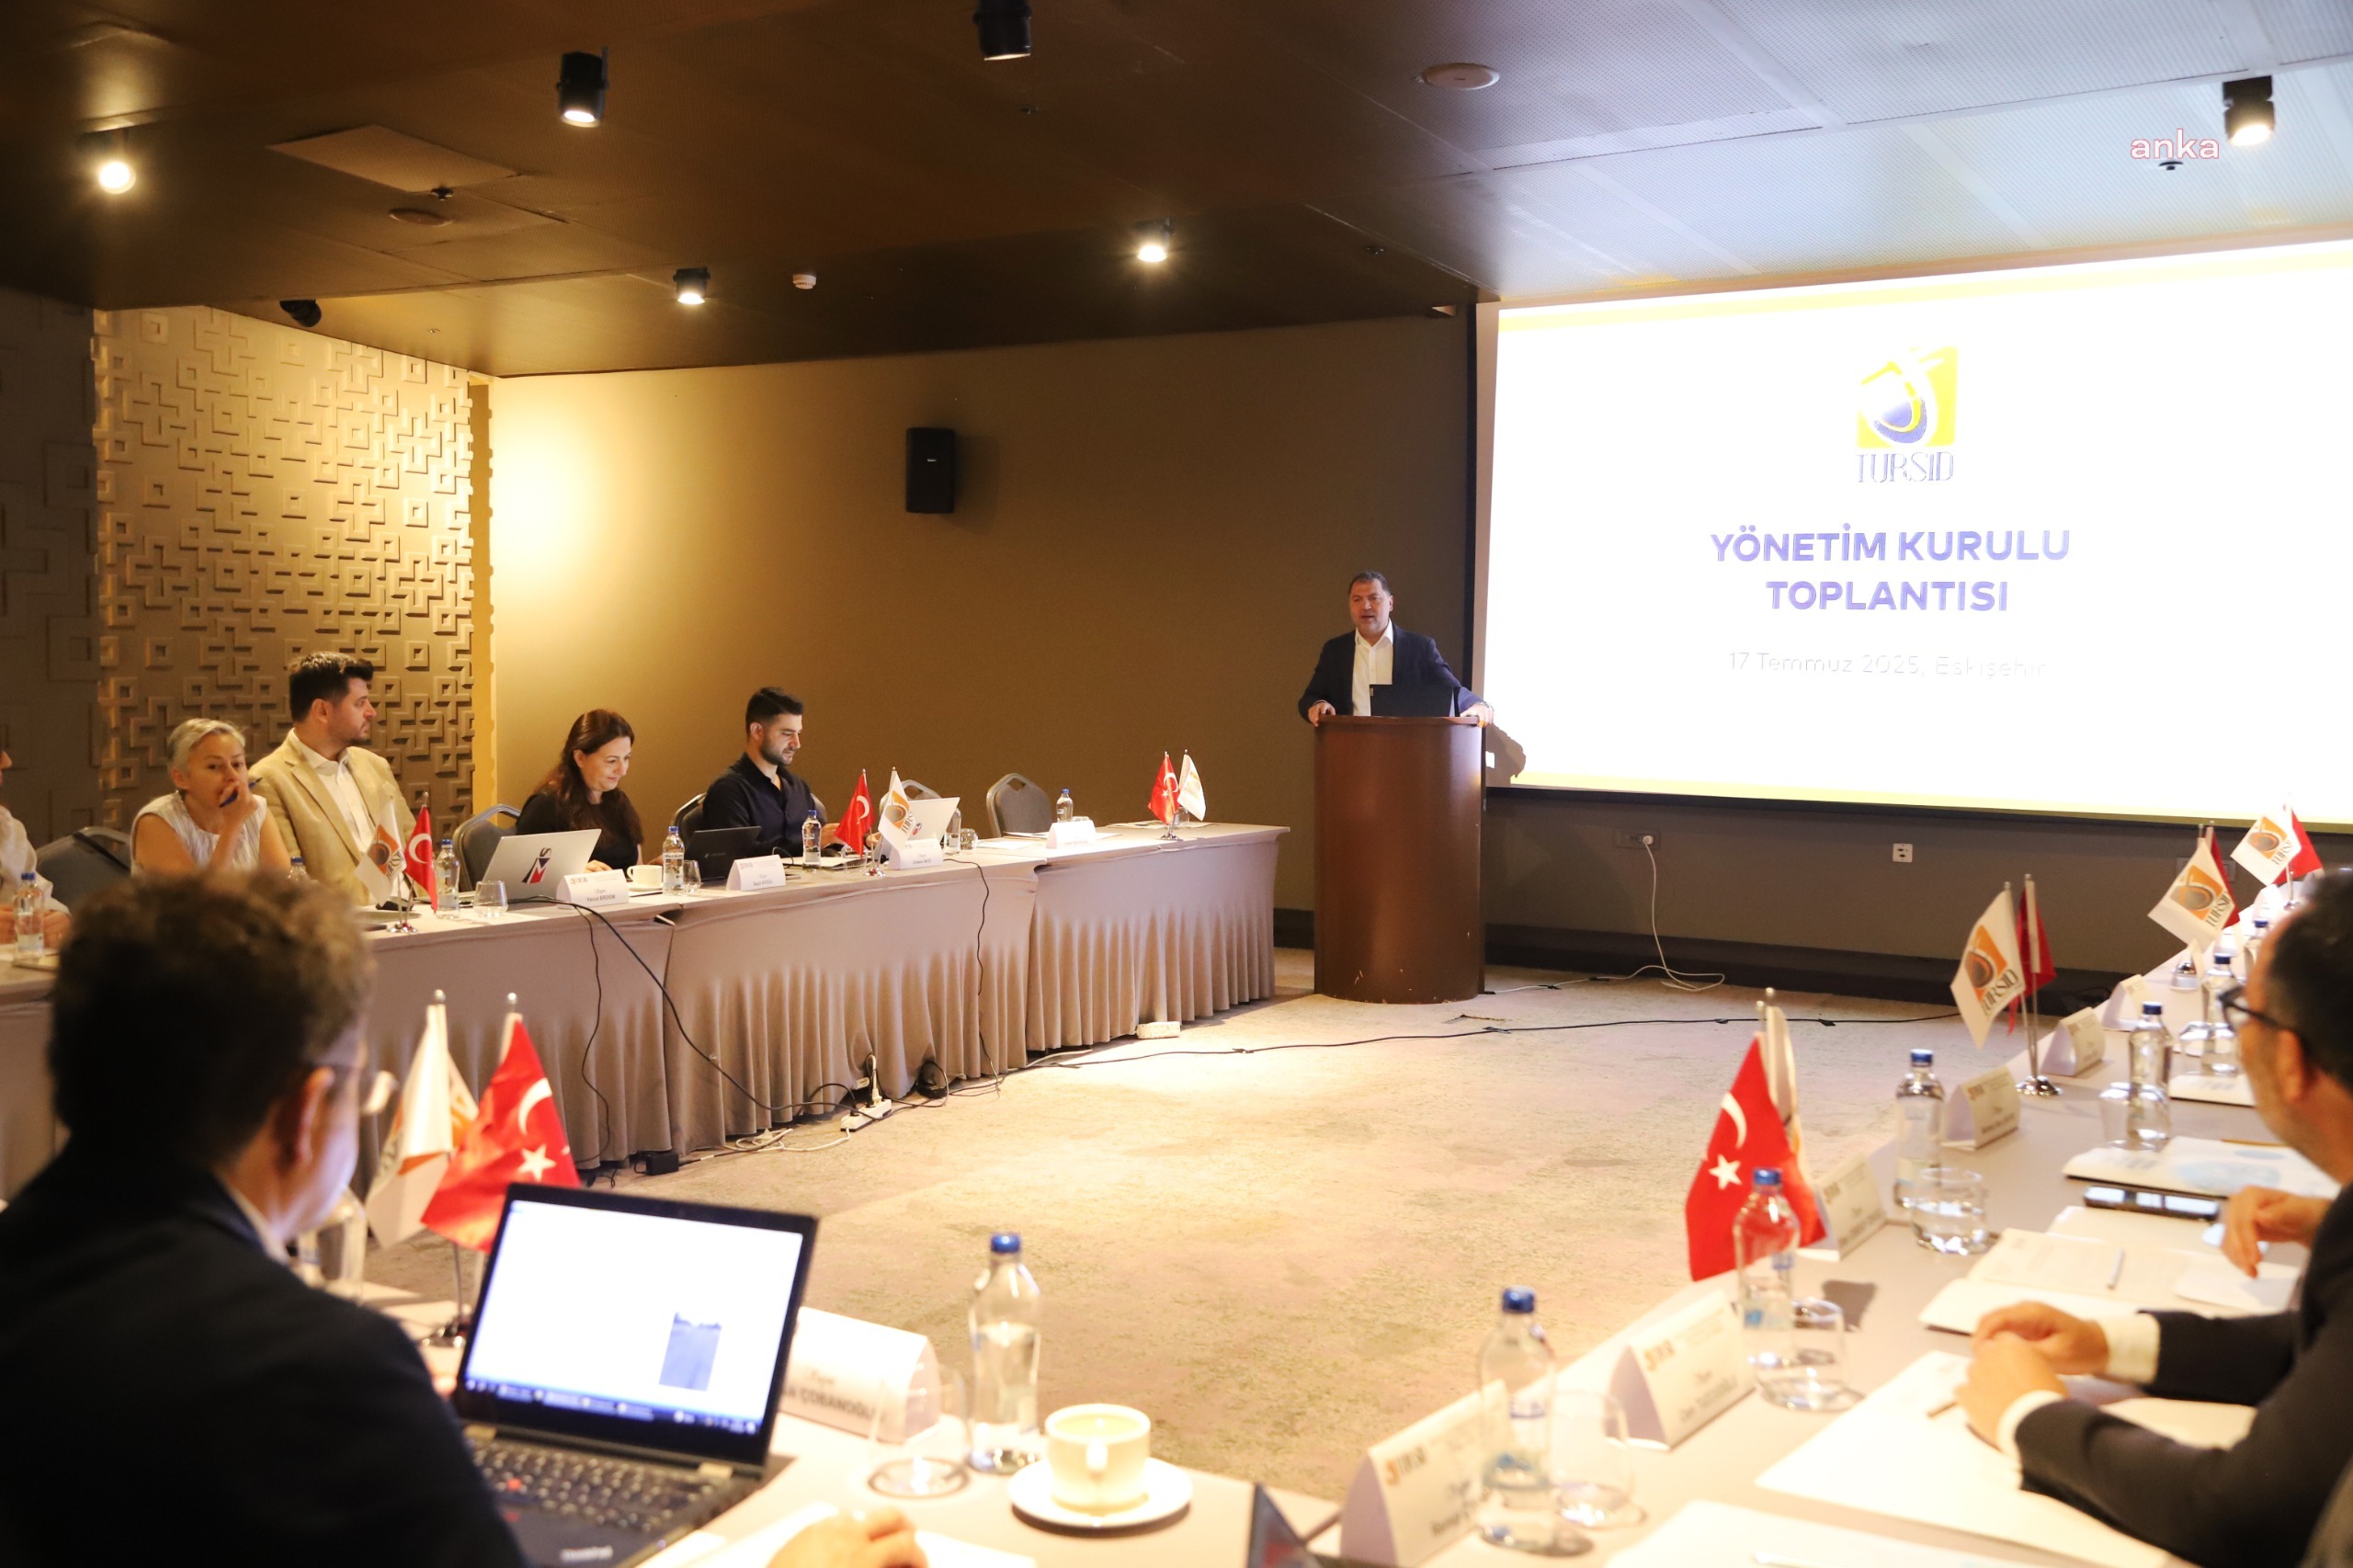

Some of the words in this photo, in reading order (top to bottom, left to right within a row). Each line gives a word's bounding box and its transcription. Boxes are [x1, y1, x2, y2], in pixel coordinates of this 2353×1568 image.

[1711, 523, 1887, 562] YÖNETİM
[1898, 529, 2070, 561] KURULU
[1766, 581, 2008, 611] TOPLANTISI
[1728, 652, 1750, 670] 17
[1756, 653, 1853, 673] Temmuz
[1862, 654, 1926, 677] 2025,
